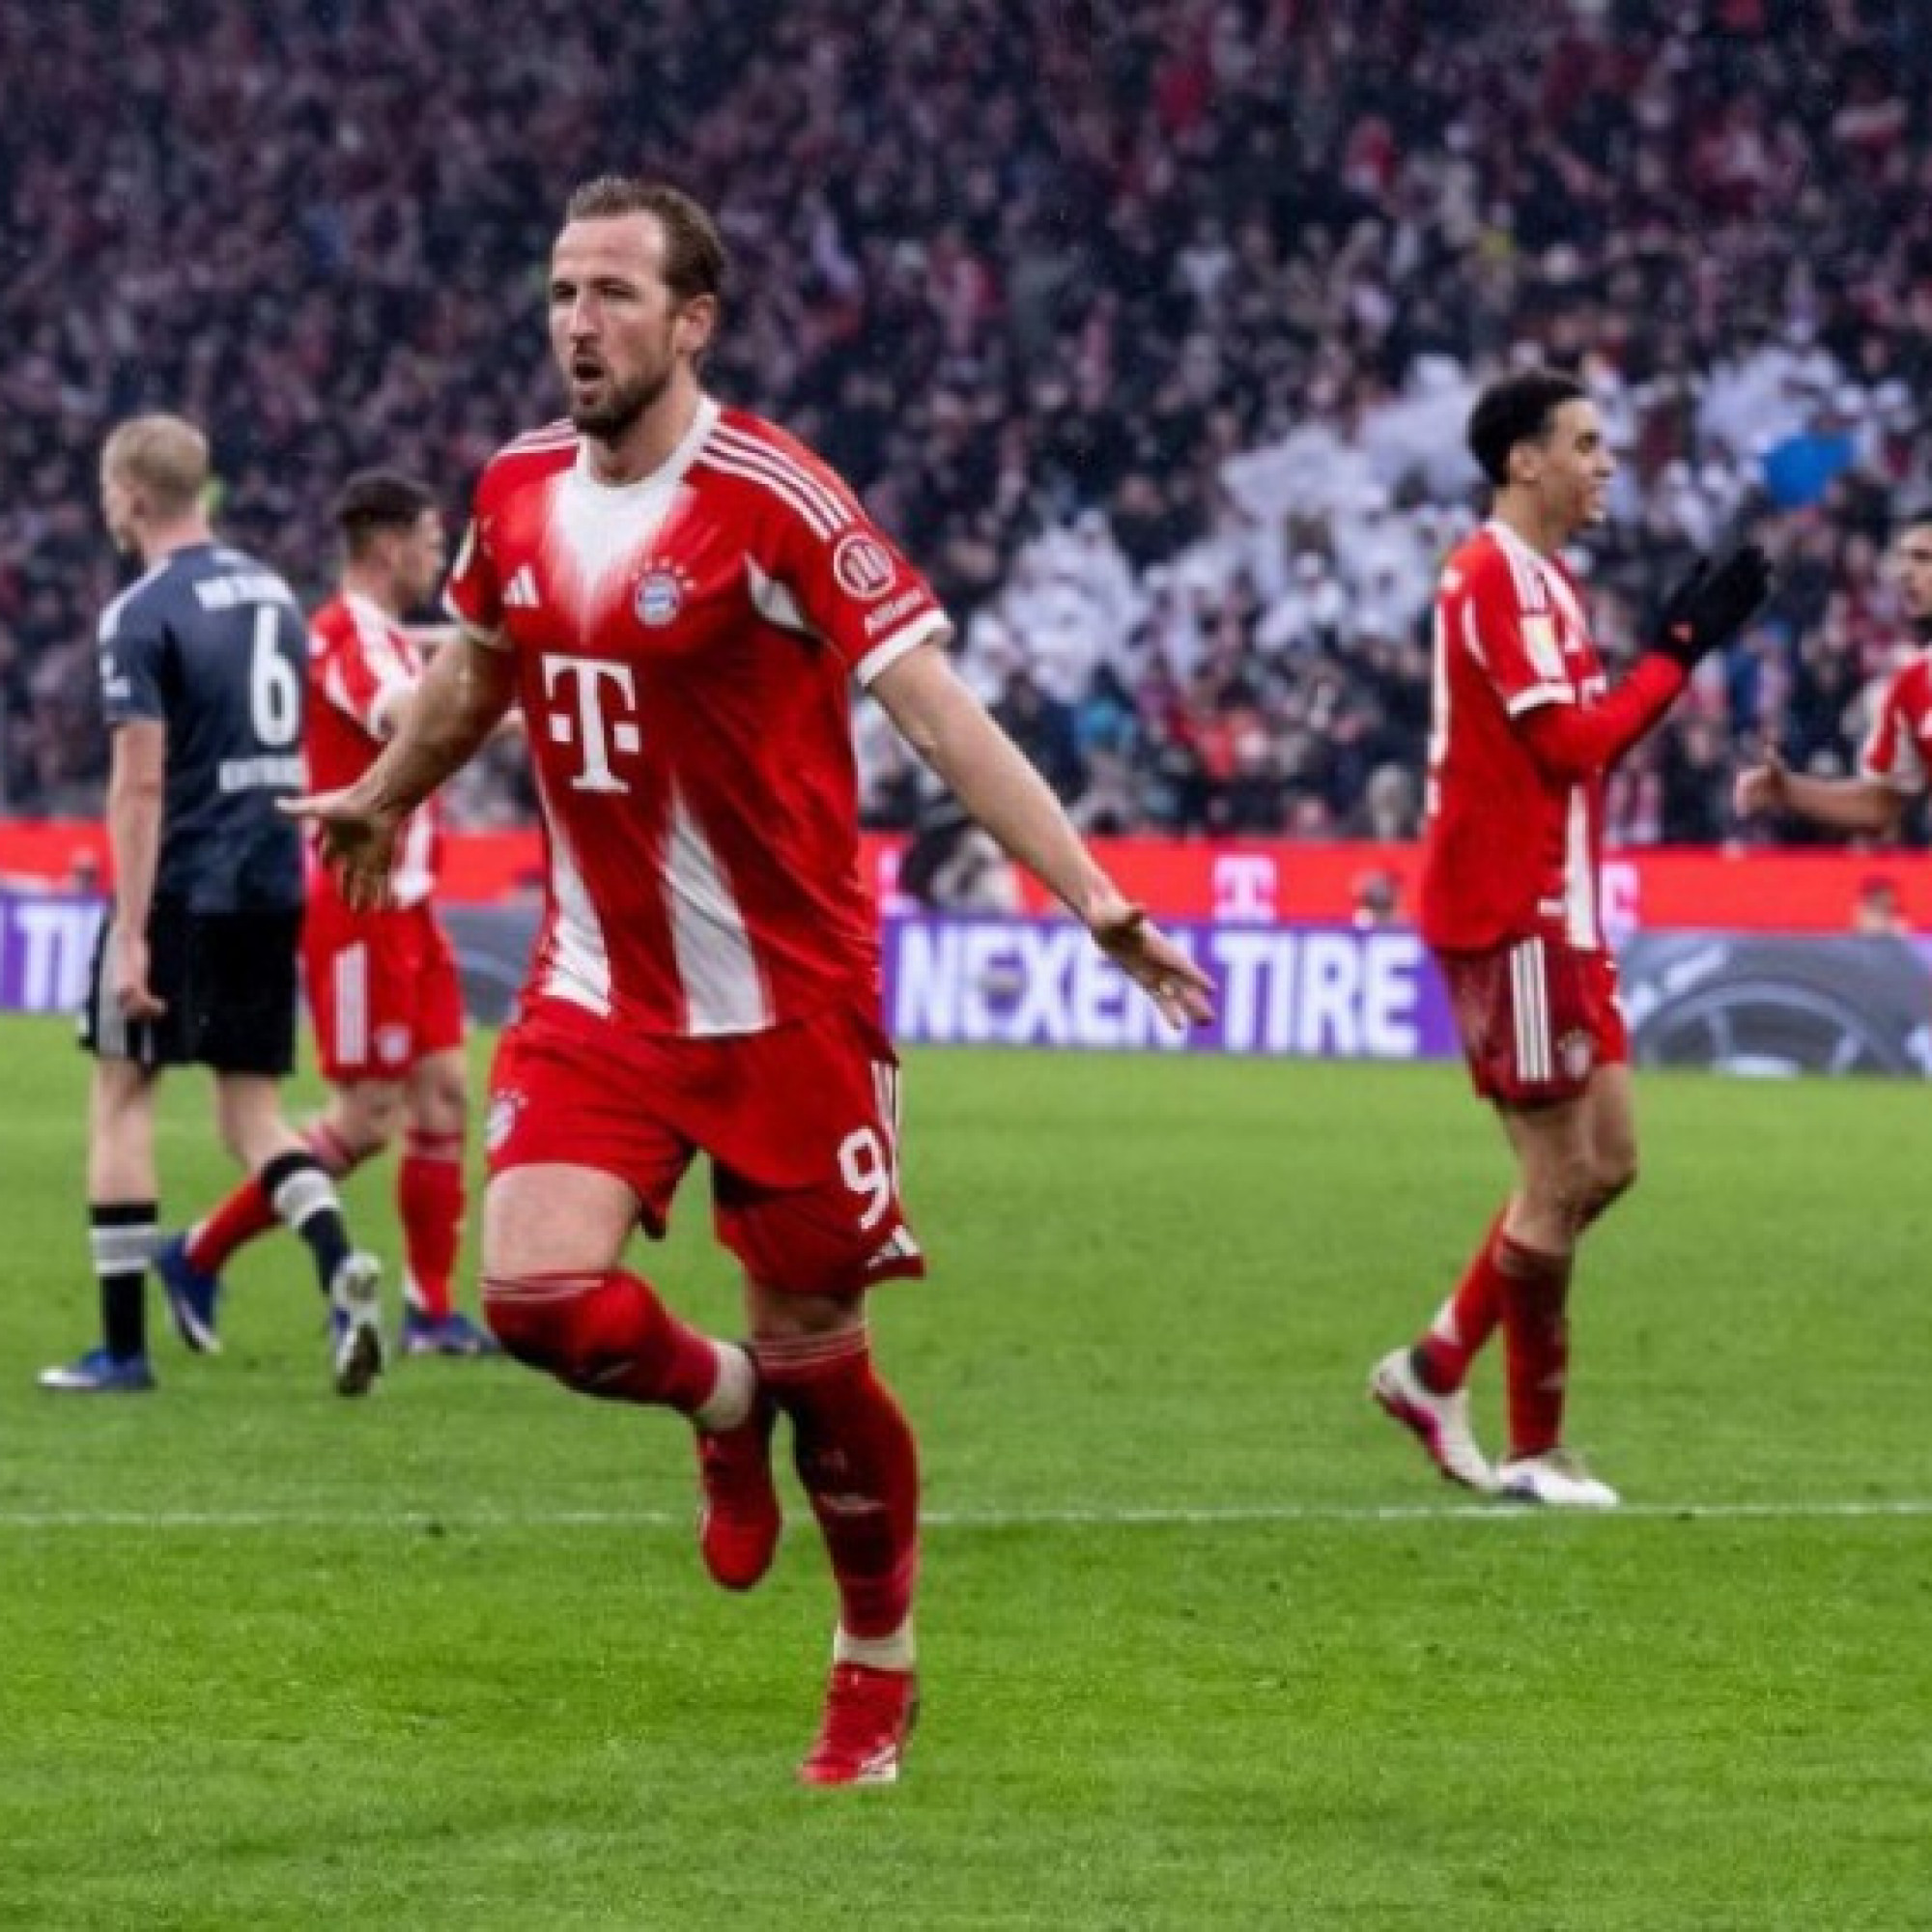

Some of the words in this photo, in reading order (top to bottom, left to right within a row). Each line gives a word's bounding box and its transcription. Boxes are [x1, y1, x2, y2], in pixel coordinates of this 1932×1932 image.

[250, 604, 299, 747] 6
[540, 653, 641, 793] T
[14, 904, 100, 1009] TI
[1211, 930, 1423, 1060] TIRE
[838, 1126, 891, 1231] 9
